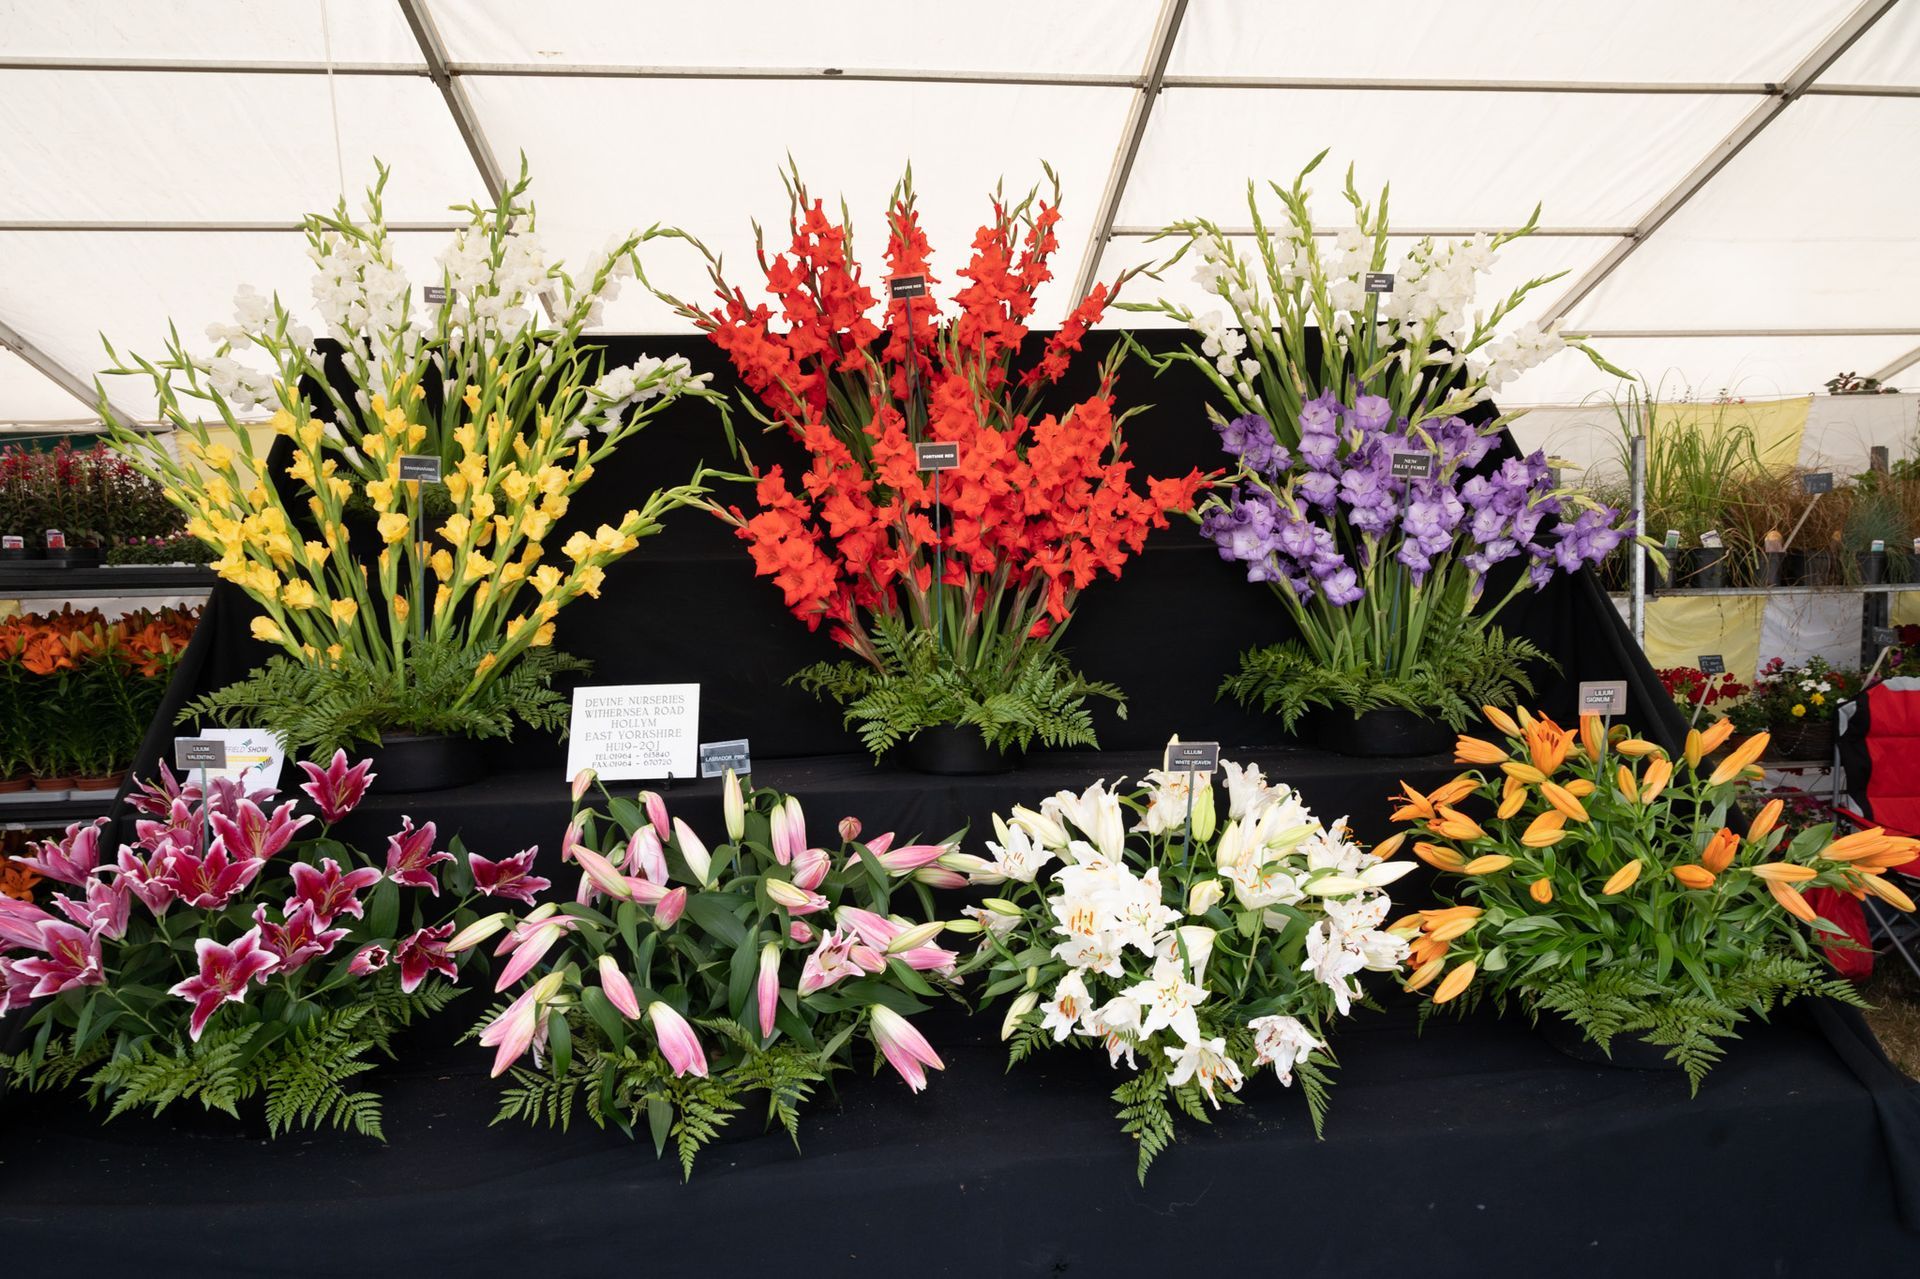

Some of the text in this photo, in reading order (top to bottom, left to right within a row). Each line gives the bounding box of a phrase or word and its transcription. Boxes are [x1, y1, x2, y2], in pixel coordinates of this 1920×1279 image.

[584, 695, 685, 708] DEVINE NURSERIES
[584, 706, 685, 719] WITHERNSEA ROAD
[611, 718, 657, 729] HOLLYM
[585, 728, 682, 741] EAST YORKSHIRE
